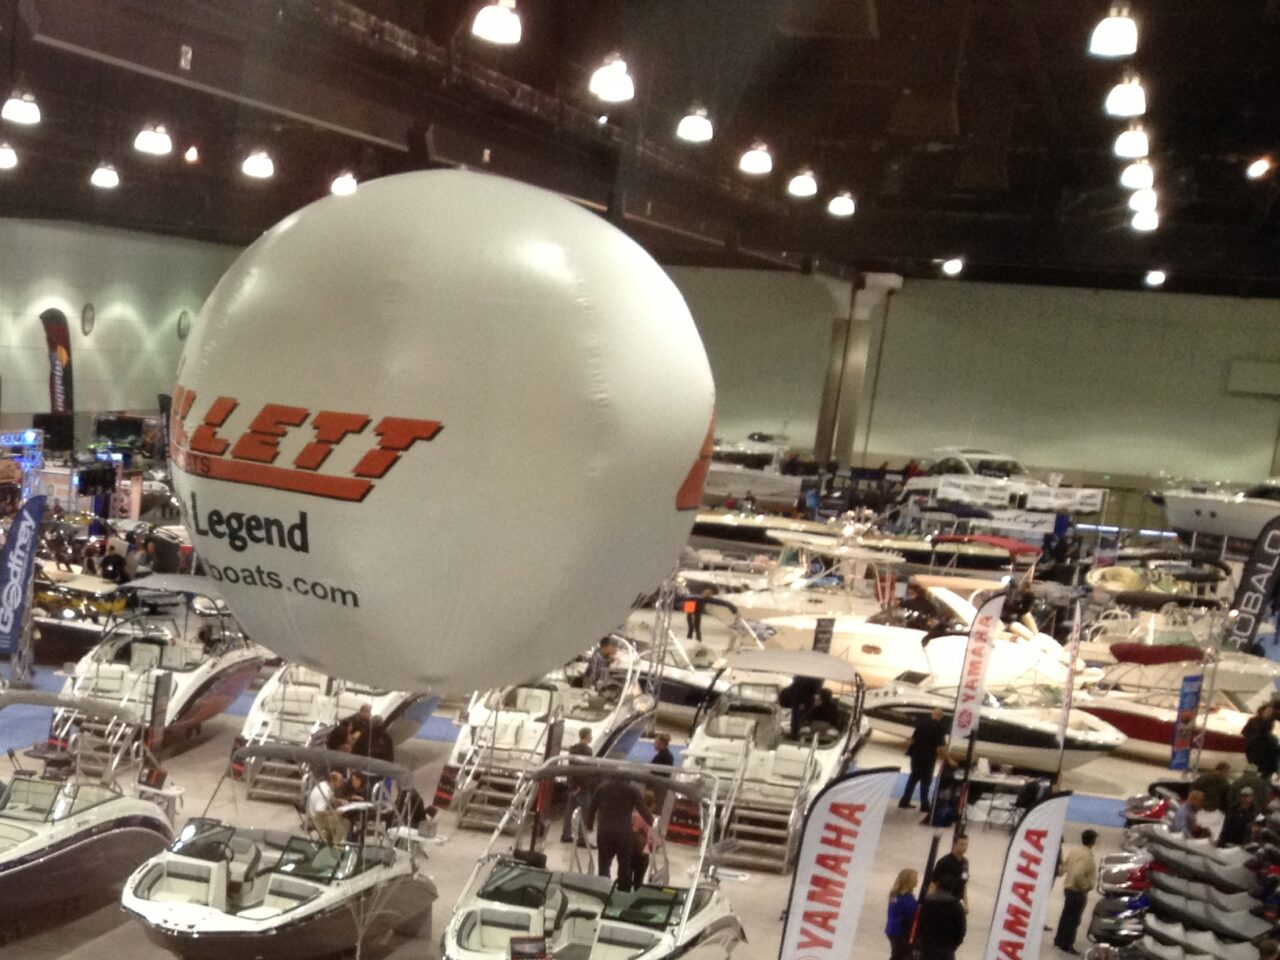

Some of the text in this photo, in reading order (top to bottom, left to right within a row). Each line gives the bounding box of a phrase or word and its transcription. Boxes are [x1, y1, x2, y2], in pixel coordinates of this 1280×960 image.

[191, 491, 309, 553] Legend
[962, 616, 993, 703] YAMAHA
[796, 800, 866, 950] YAMAHA
